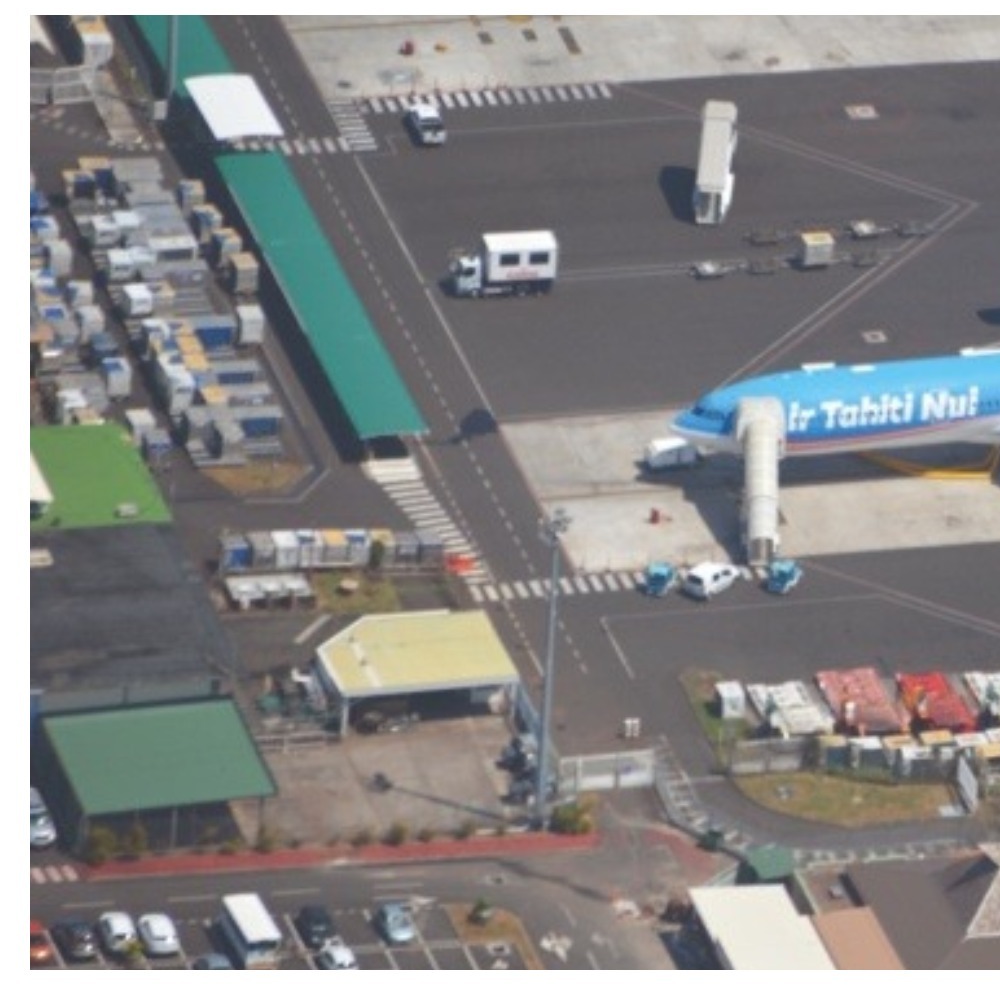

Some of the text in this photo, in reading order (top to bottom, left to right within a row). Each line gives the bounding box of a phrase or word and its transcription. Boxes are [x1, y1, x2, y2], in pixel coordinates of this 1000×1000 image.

[788, 386, 979, 432] ir Tahiti Nui
